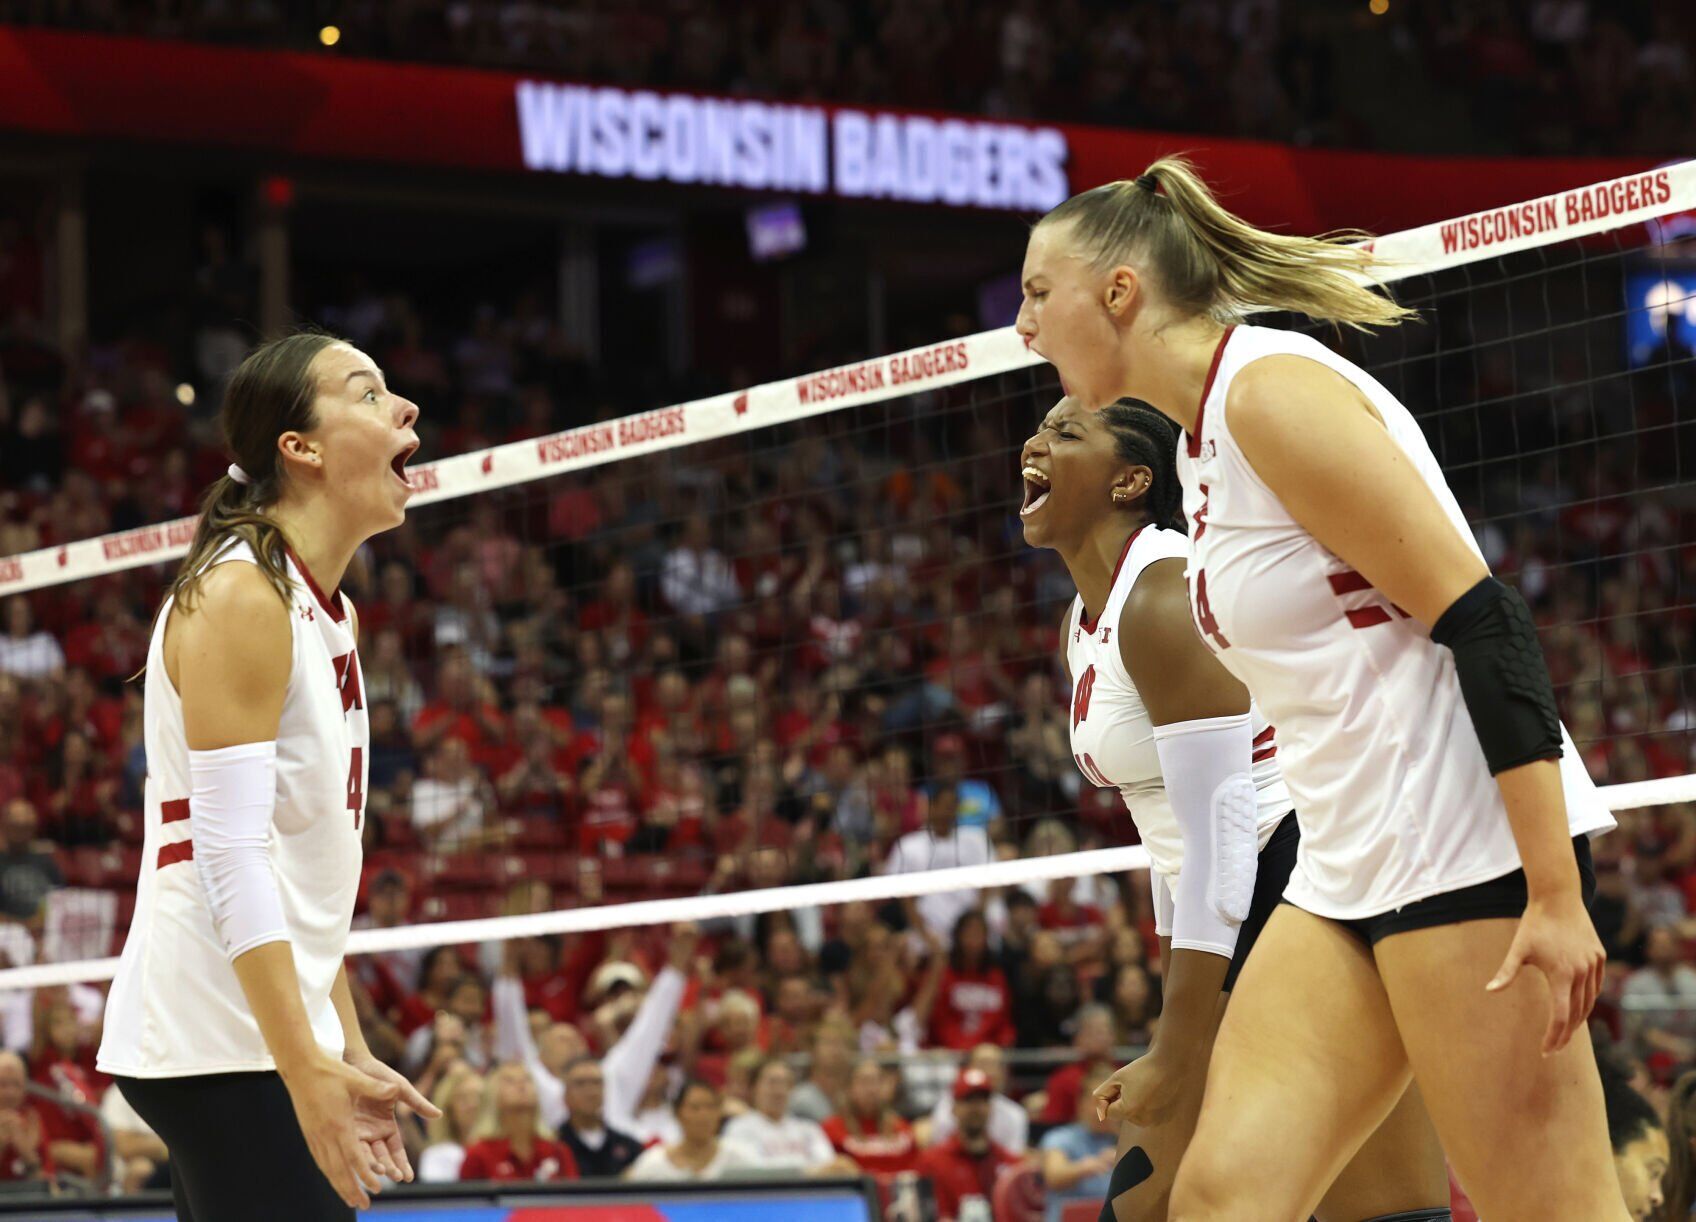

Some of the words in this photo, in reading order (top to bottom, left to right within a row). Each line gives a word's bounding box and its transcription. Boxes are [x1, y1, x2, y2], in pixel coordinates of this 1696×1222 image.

[516, 80, 827, 193] WISCONSIN
[833, 109, 1069, 213] BADGERS
[1440, 196, 1558, 254] WISCONSIN
[1564, 171, 1671, 227] BADGERS
[797, 362, 885, 405] WISCONSIN
[889, 342, 970, 386] BADGERS
[537, 425, 615, 464] WISCONSIN
[346, 747, 362, 830] 4
